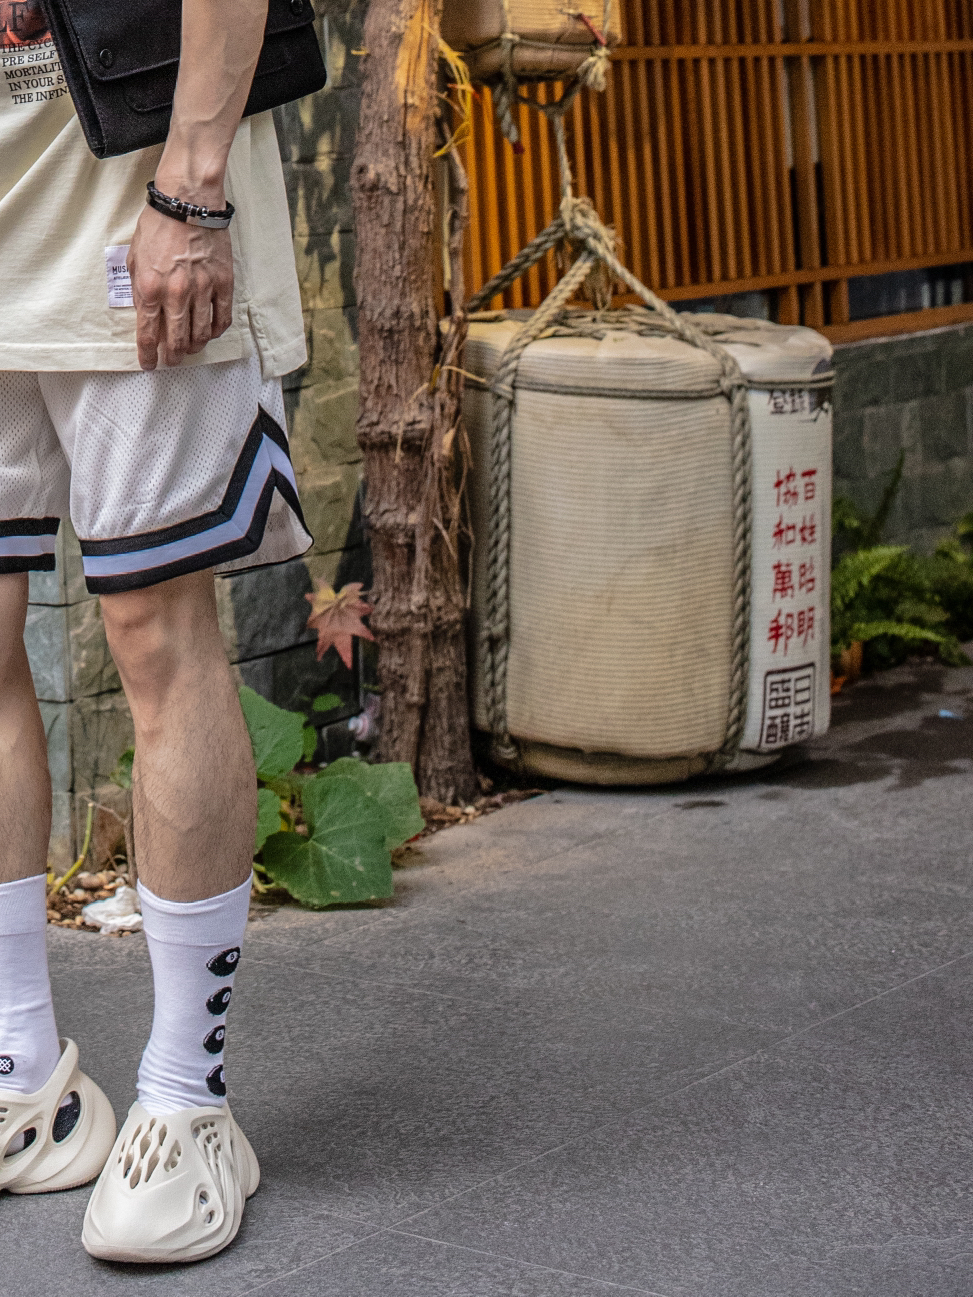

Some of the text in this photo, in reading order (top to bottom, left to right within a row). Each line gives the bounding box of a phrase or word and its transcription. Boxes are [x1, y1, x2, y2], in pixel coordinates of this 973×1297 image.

[2, 43, 25, 54] THE
[2, 49, 57, 68] PRE SELF
[3, 62, 63, 81] MORTALIT
[8, 80, 22, 92] IN
[22, 76, 54, 90] YOUR
[12, 86, 70, 105] THE INFIN
